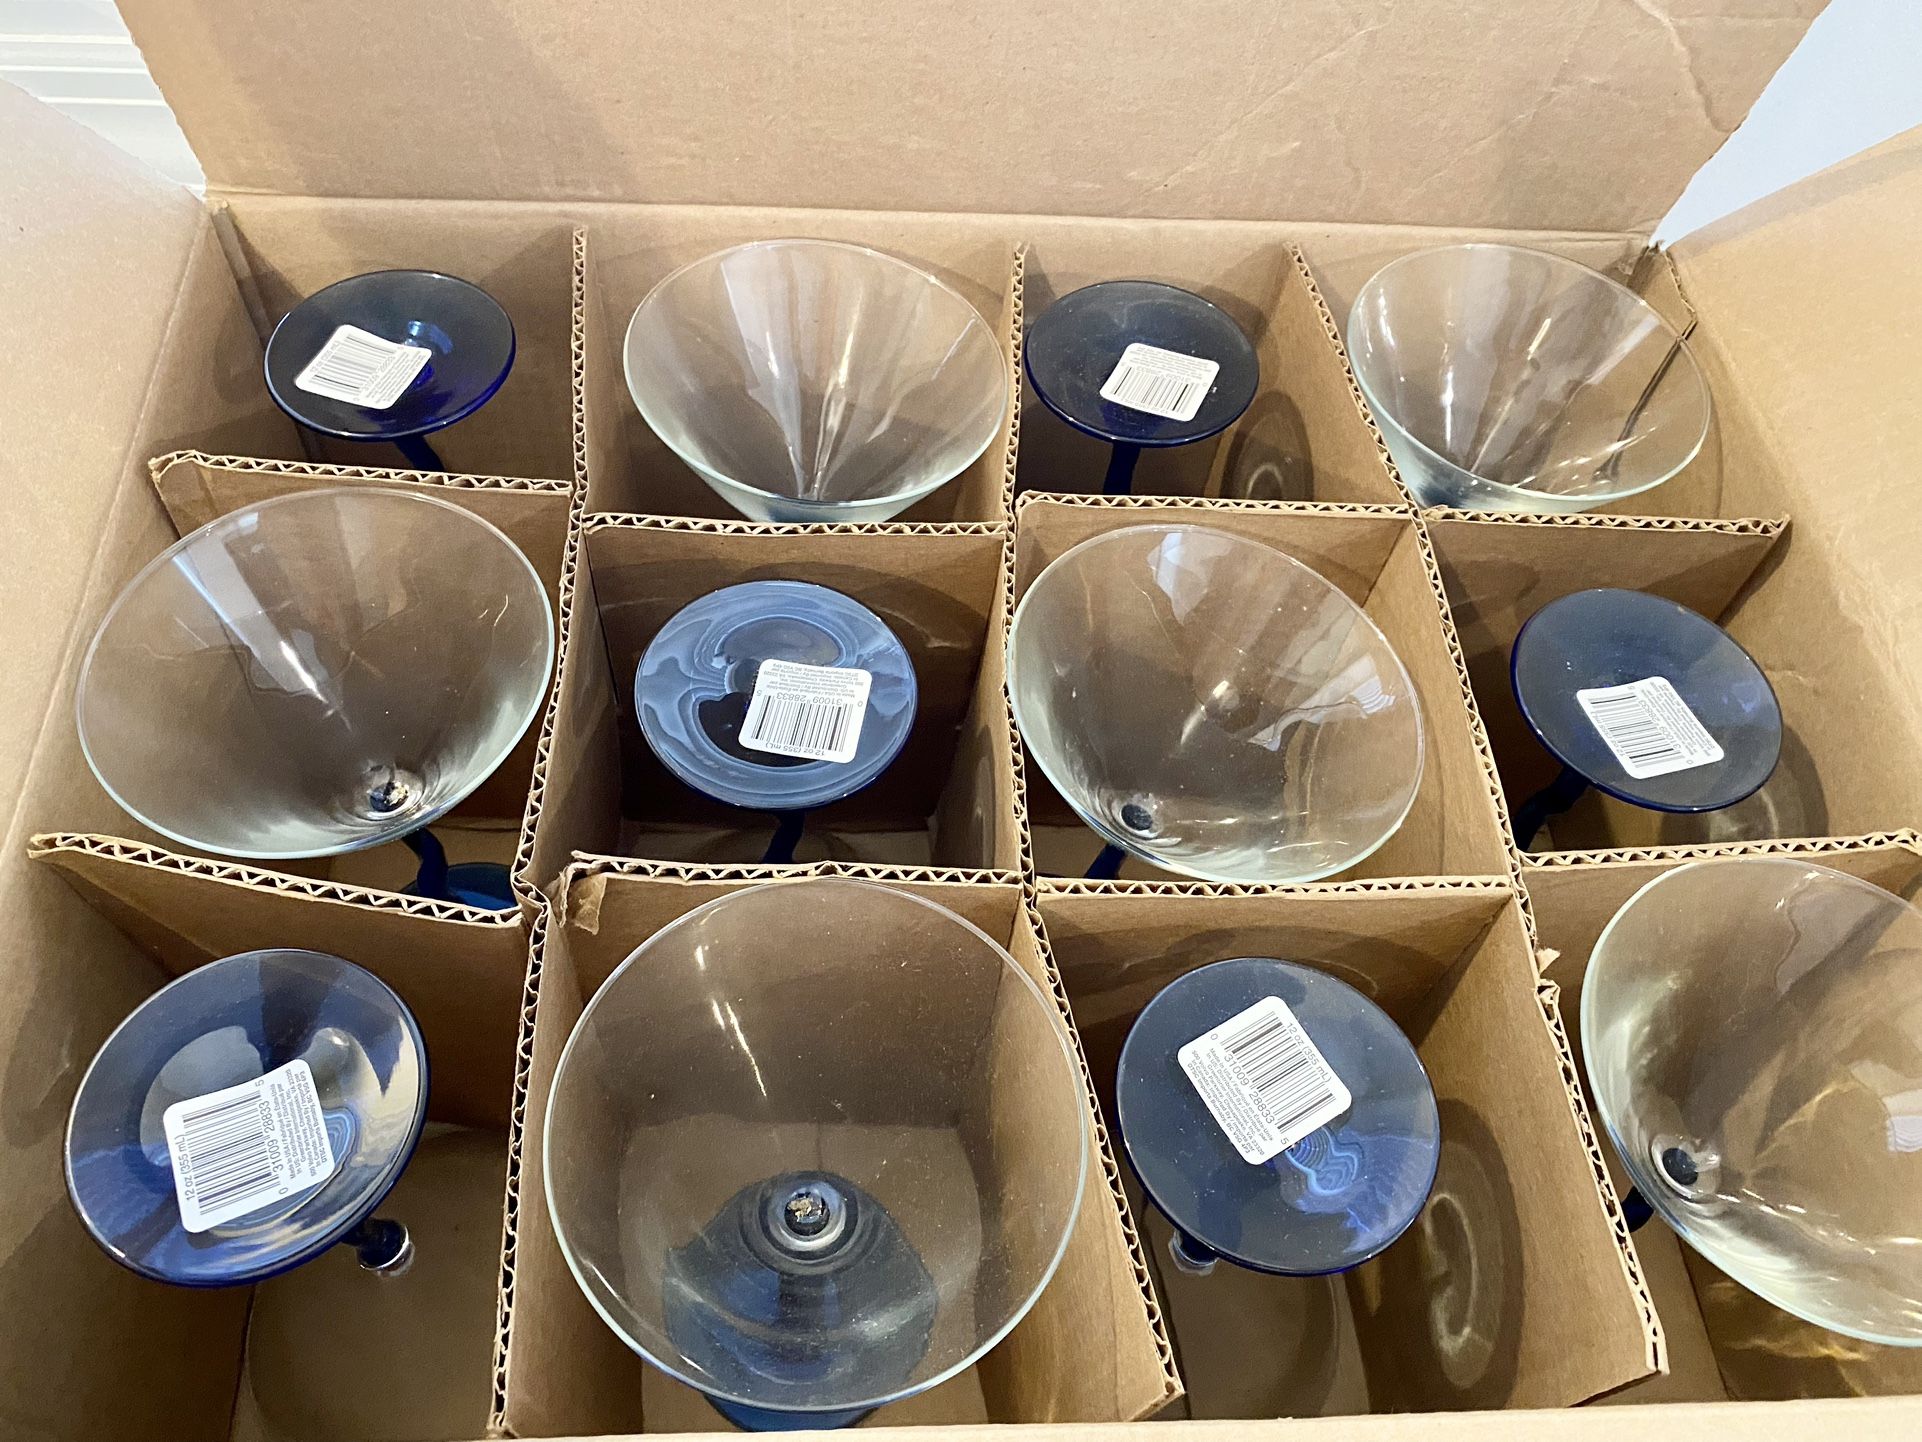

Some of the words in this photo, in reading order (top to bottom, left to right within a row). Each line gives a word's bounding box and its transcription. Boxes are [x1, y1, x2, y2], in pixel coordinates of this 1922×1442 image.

[776, 692, 807, 702] 28833
[812, 696, 843, 706] 31009
[1287, 1022, 1298, 1035] 12
[1294, 1034, 1304, 1046] oz
[1302, 1046, 1320, 1066] (355
[1316, 1066, 1332, 1083] mL)
[255, 1079, 265, 1087] 5
[258, 1101, 275, 1133] 28833
[174, 1134, 187, 1152] mL)
[267, 1139, 284, 1173] 31009
[178, 1153, 192, 1175] (355
[184, 1175, 193, 1188] oz
[184, 1188, 196, 1201] 12
[278, 1187, 289, 1195] 0
